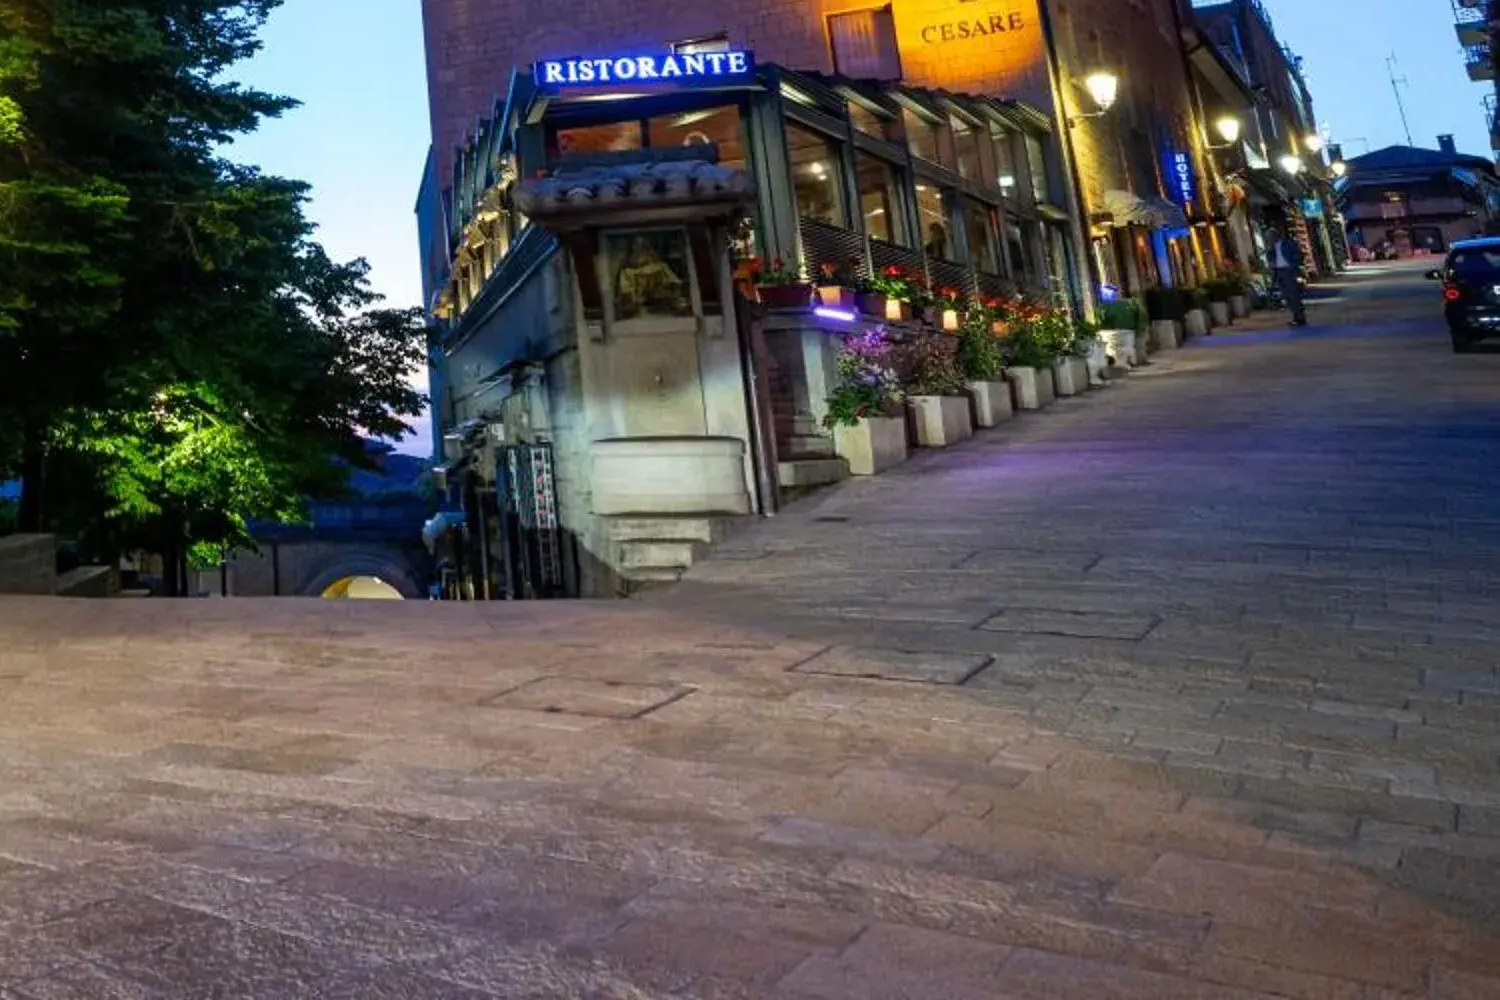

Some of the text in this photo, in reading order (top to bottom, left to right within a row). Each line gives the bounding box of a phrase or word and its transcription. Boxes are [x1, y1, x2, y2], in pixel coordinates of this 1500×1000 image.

[921, 12, 1025, 44] CESARE
[545, 52, 748, 83] RISTORANTE
[1175, 153, 1192, 200] HOTEL
